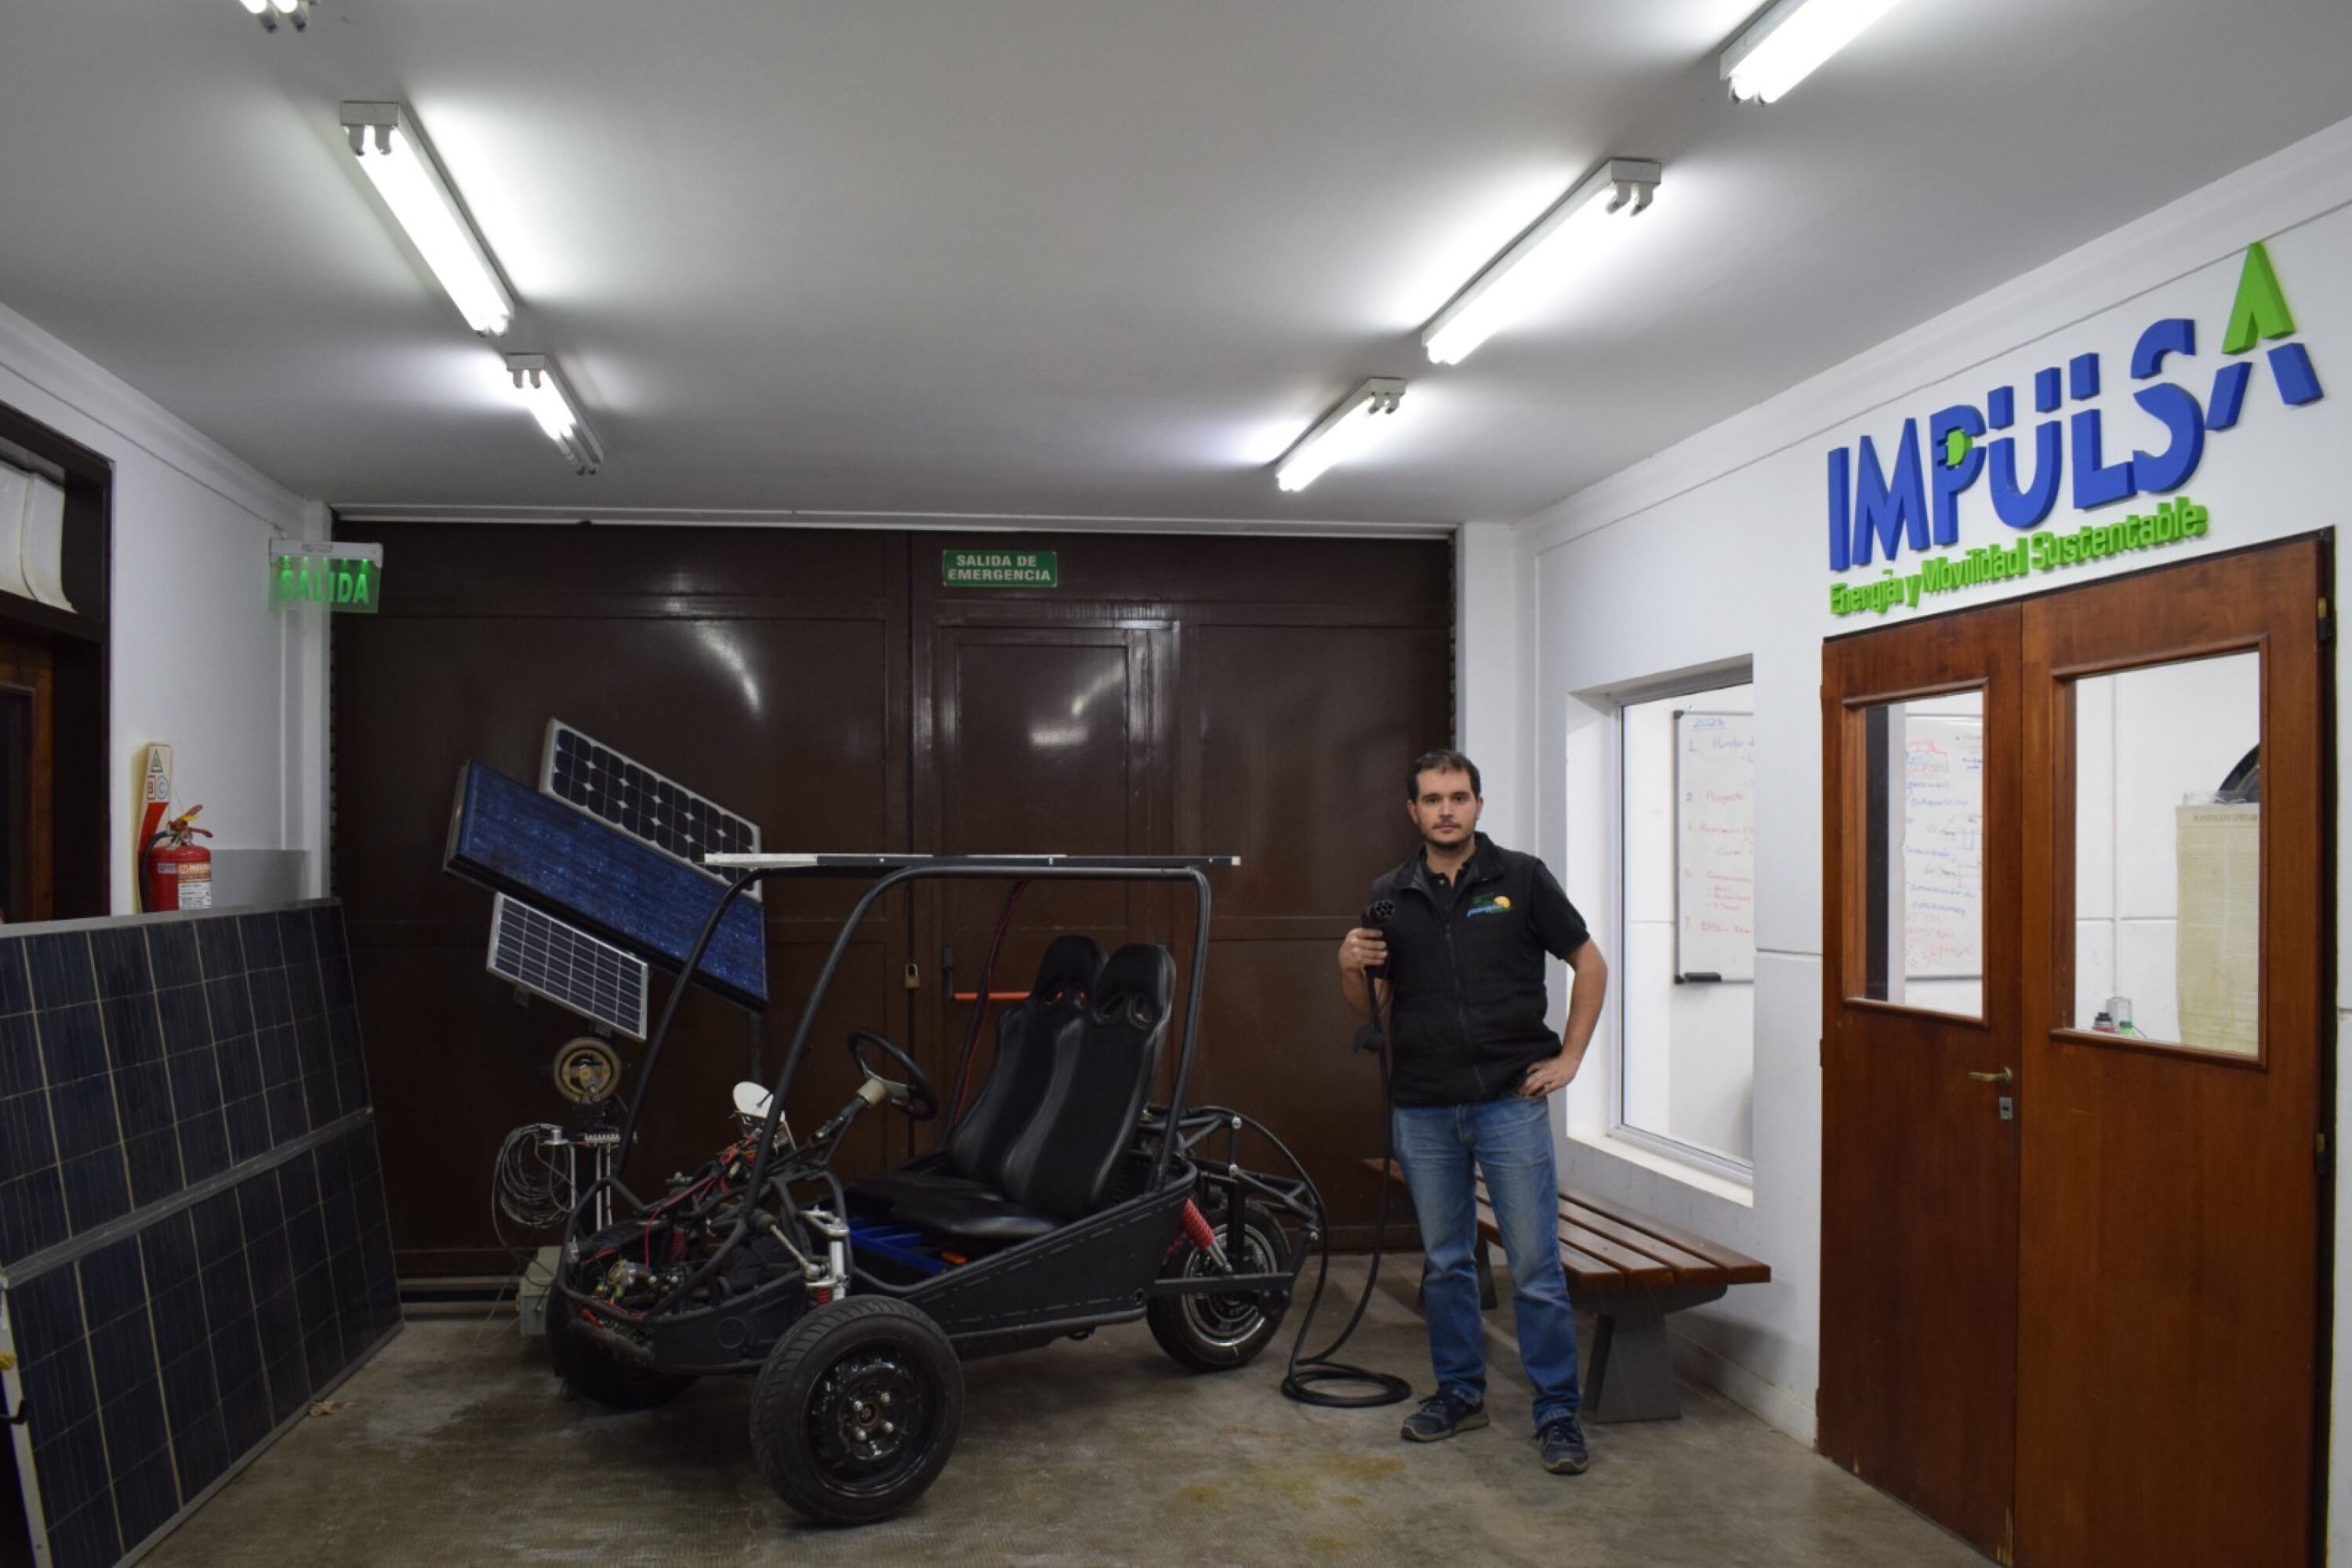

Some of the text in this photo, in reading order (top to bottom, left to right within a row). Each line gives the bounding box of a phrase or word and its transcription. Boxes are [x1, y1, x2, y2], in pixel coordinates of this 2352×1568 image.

[1828, 241, 2324, 572] IMPULSA
[956, 554, 1037, 567] SALIDA DE
[1830, 496, 2209, 615] Energía y Movilidad Sustentable
[279, 569, 370, 603] SALIDA
[948, 569, 1051, 581] EMERGENCIA
